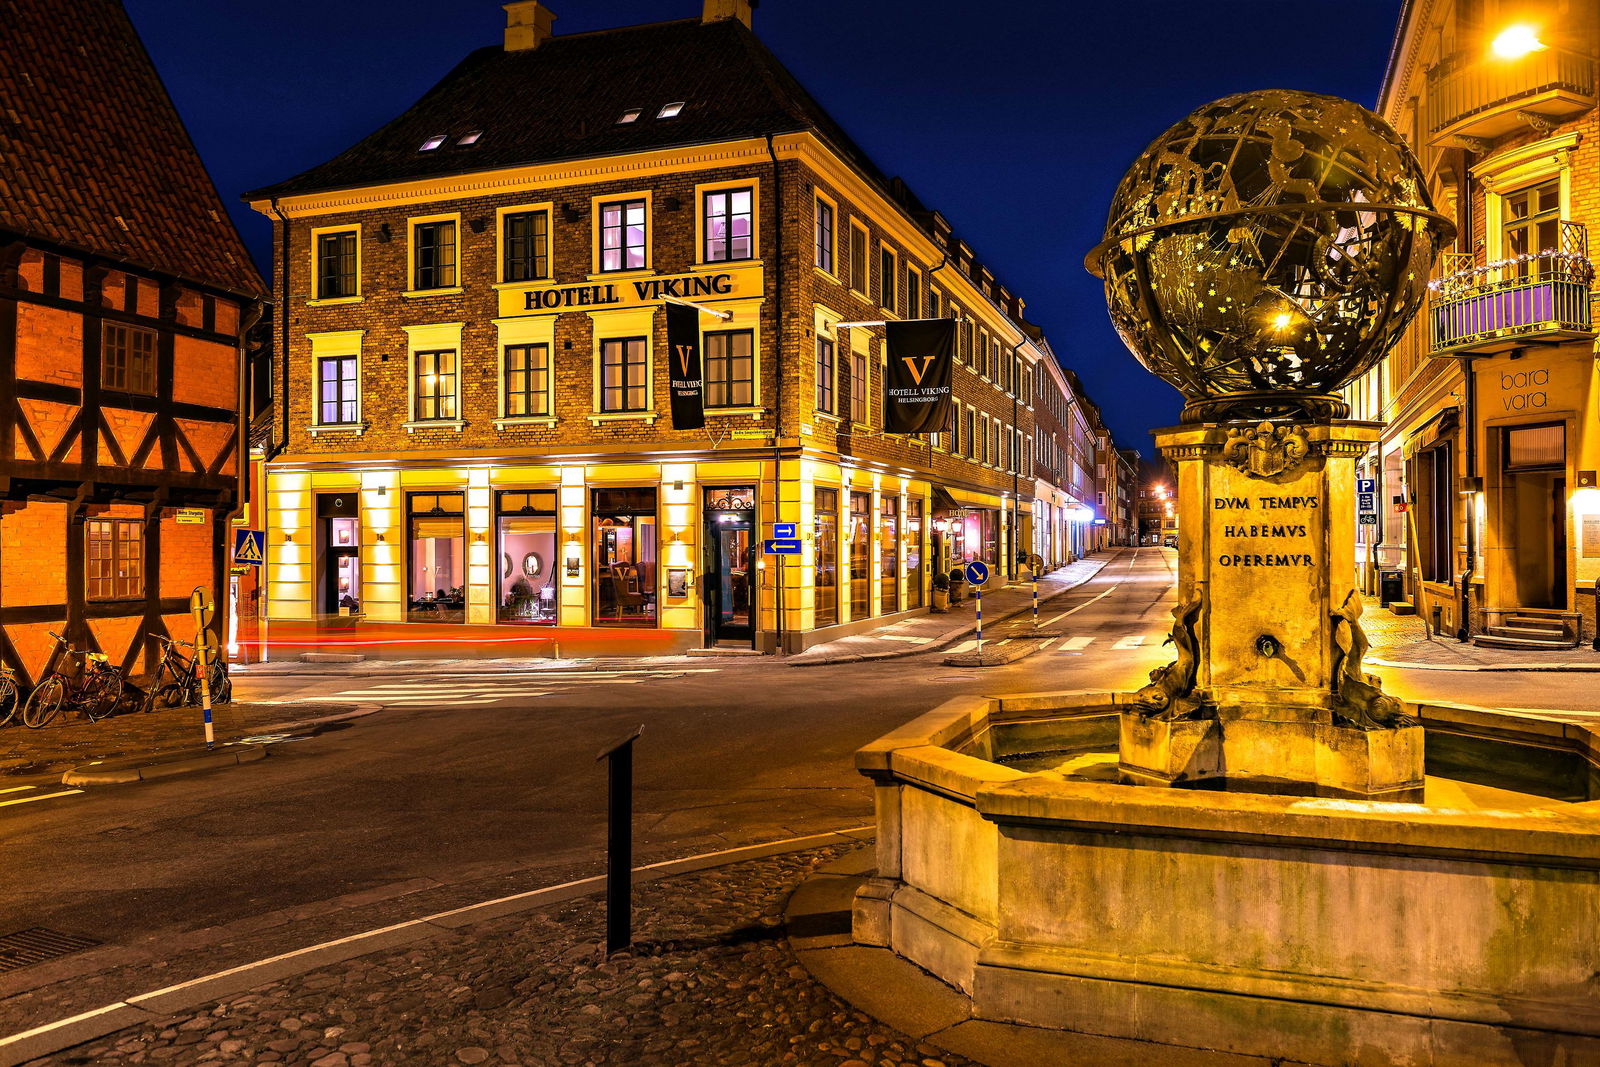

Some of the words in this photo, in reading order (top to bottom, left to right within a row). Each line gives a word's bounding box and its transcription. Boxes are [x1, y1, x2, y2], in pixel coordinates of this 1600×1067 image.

[524, 284, 619, 310] HOTELL
[633, 274, 732, 301] VIKING
[675, 344, 693, 377] V
[901, 355, 936, 386] V
[1500, 368, 1549, 390] bara
[888, 388, 919, 396] HOTELL
[920, 386, 950, 395] VIKING
[1502, 391, 1547, 411] vara
[1361, 480, 1371, 492] P
[1214, 497, 1251, 510] DVM
[1258, 496, 1319, 510] TEMPVS
[1225, 525, 1307, 537] HABEMVS
[1219, 554, 1316, 567] OPEREMVR
